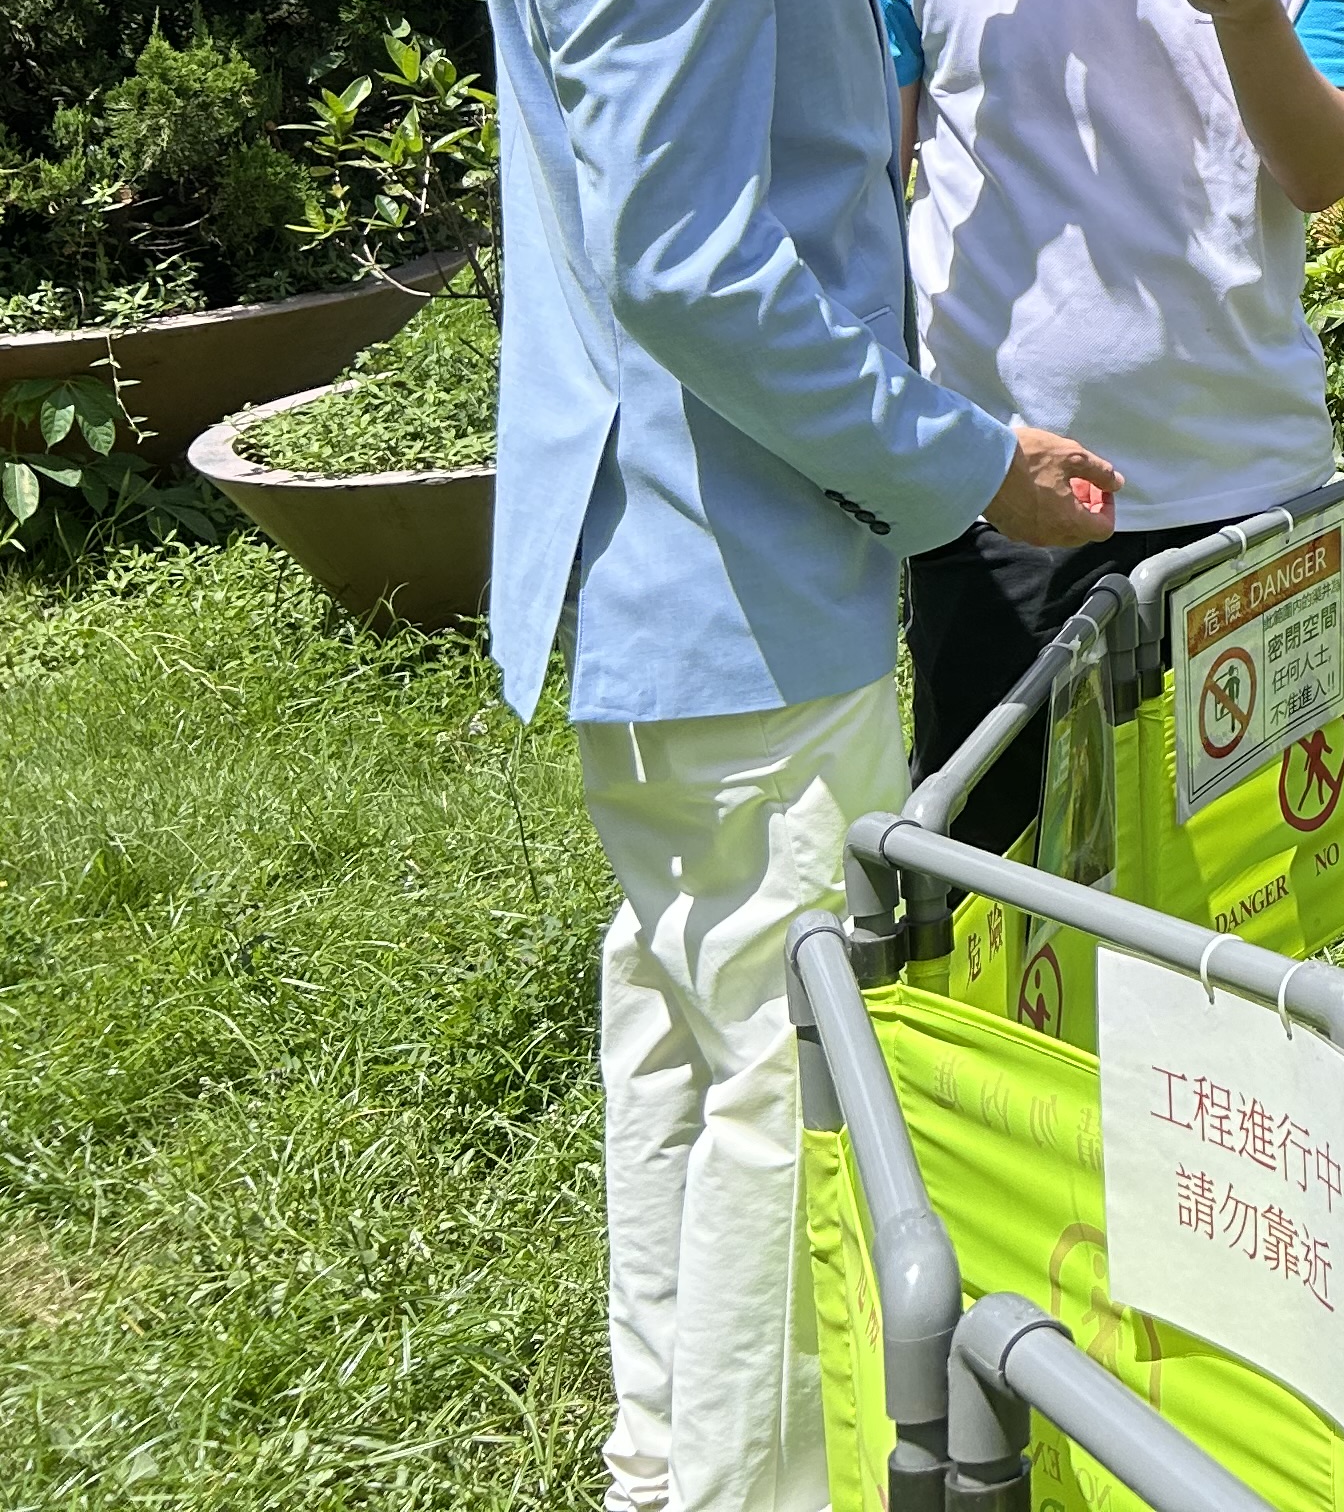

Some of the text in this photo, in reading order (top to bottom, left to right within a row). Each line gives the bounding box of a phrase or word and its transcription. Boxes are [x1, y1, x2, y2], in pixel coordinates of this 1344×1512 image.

[1203, 546, 1327, 640] 危險 DANGER
[1268, 601, 1337, 664] 密閉空間
[1215, 873, 1290, 934] DANGER
[1314, 840, 1340, 877] NO
[966, 902, 1004, 991] 危險
[1150, 1063, 1344, 1215] 工程進行中
[1175, 1163, 1336, 1313] 請勿靠近
